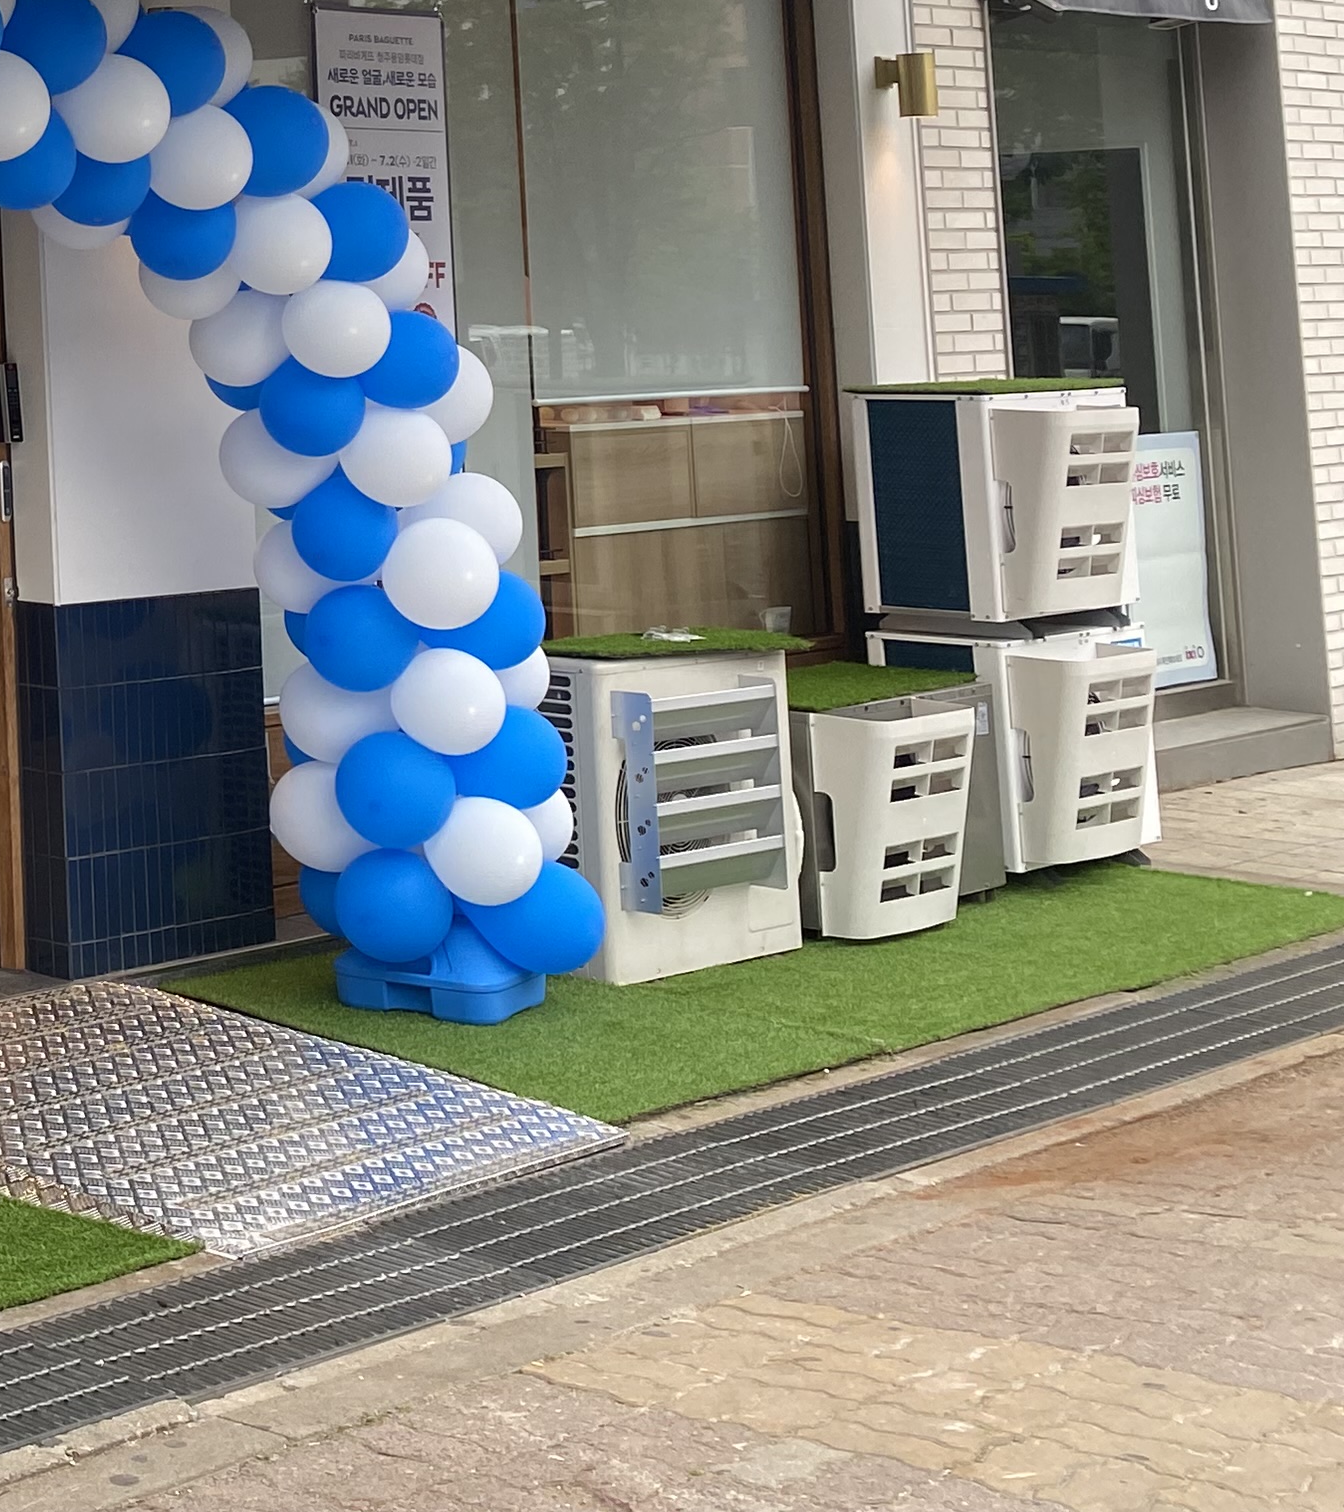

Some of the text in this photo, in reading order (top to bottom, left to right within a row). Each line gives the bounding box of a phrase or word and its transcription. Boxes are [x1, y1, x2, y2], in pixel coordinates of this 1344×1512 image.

[348, 33, 415, 46] PARIS BAGUETTE
[327, 67, 359, 85] 새로운
[417, 72, 437, 89] 모습
[329, 94, 439, 121] GRAND OPEN
[1163, 483, 1182, 503] 무료
